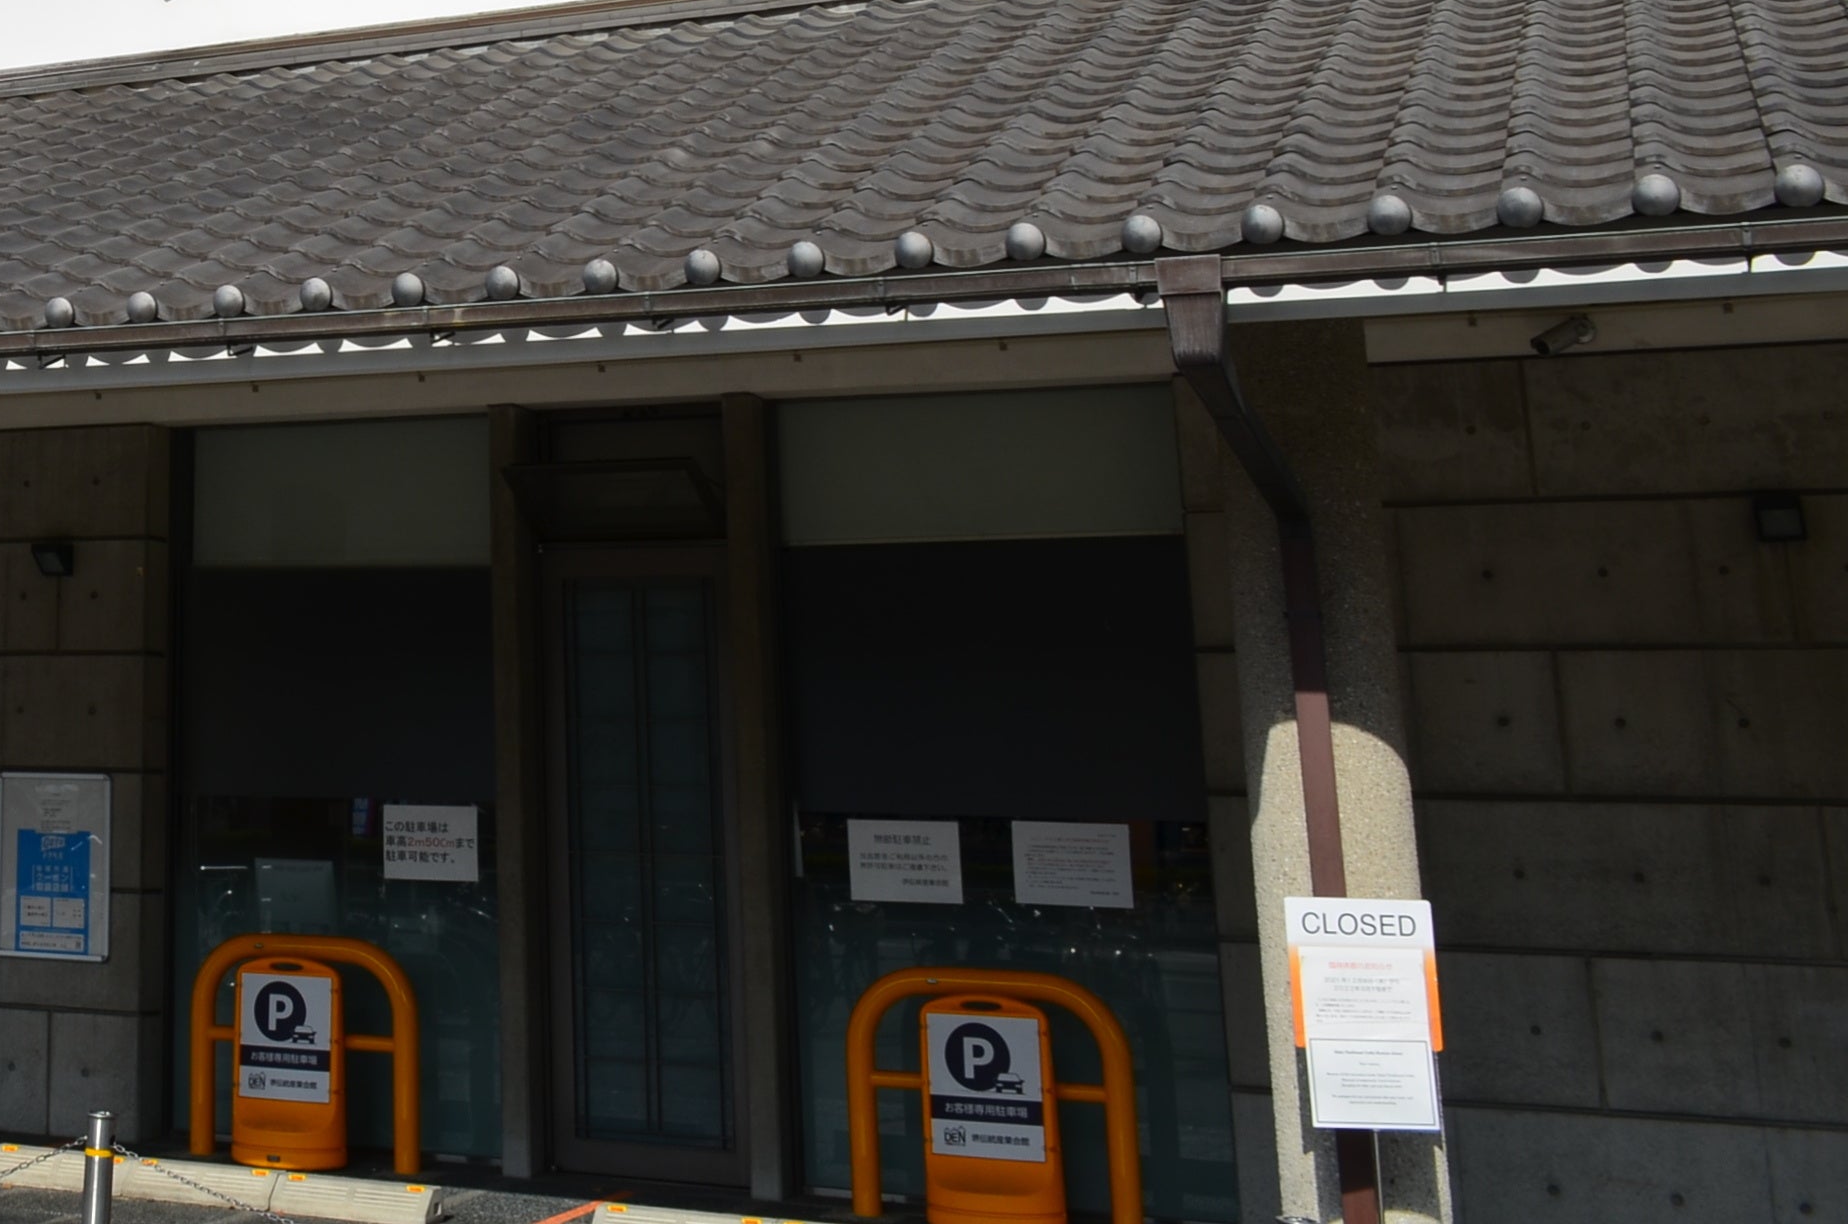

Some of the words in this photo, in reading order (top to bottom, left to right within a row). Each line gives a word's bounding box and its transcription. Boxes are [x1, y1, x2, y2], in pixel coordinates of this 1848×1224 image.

[385, 821, 449, 833] この駐車場は
[1301, 911, 1417, 937] CLOSED
[268, 993, 294, 1032] P
[963, 1036, 995, 1079] P
[944, 1102, 1029, 1119] お客様専用駐車場
[944, 1128, 966, 1144] DEN
